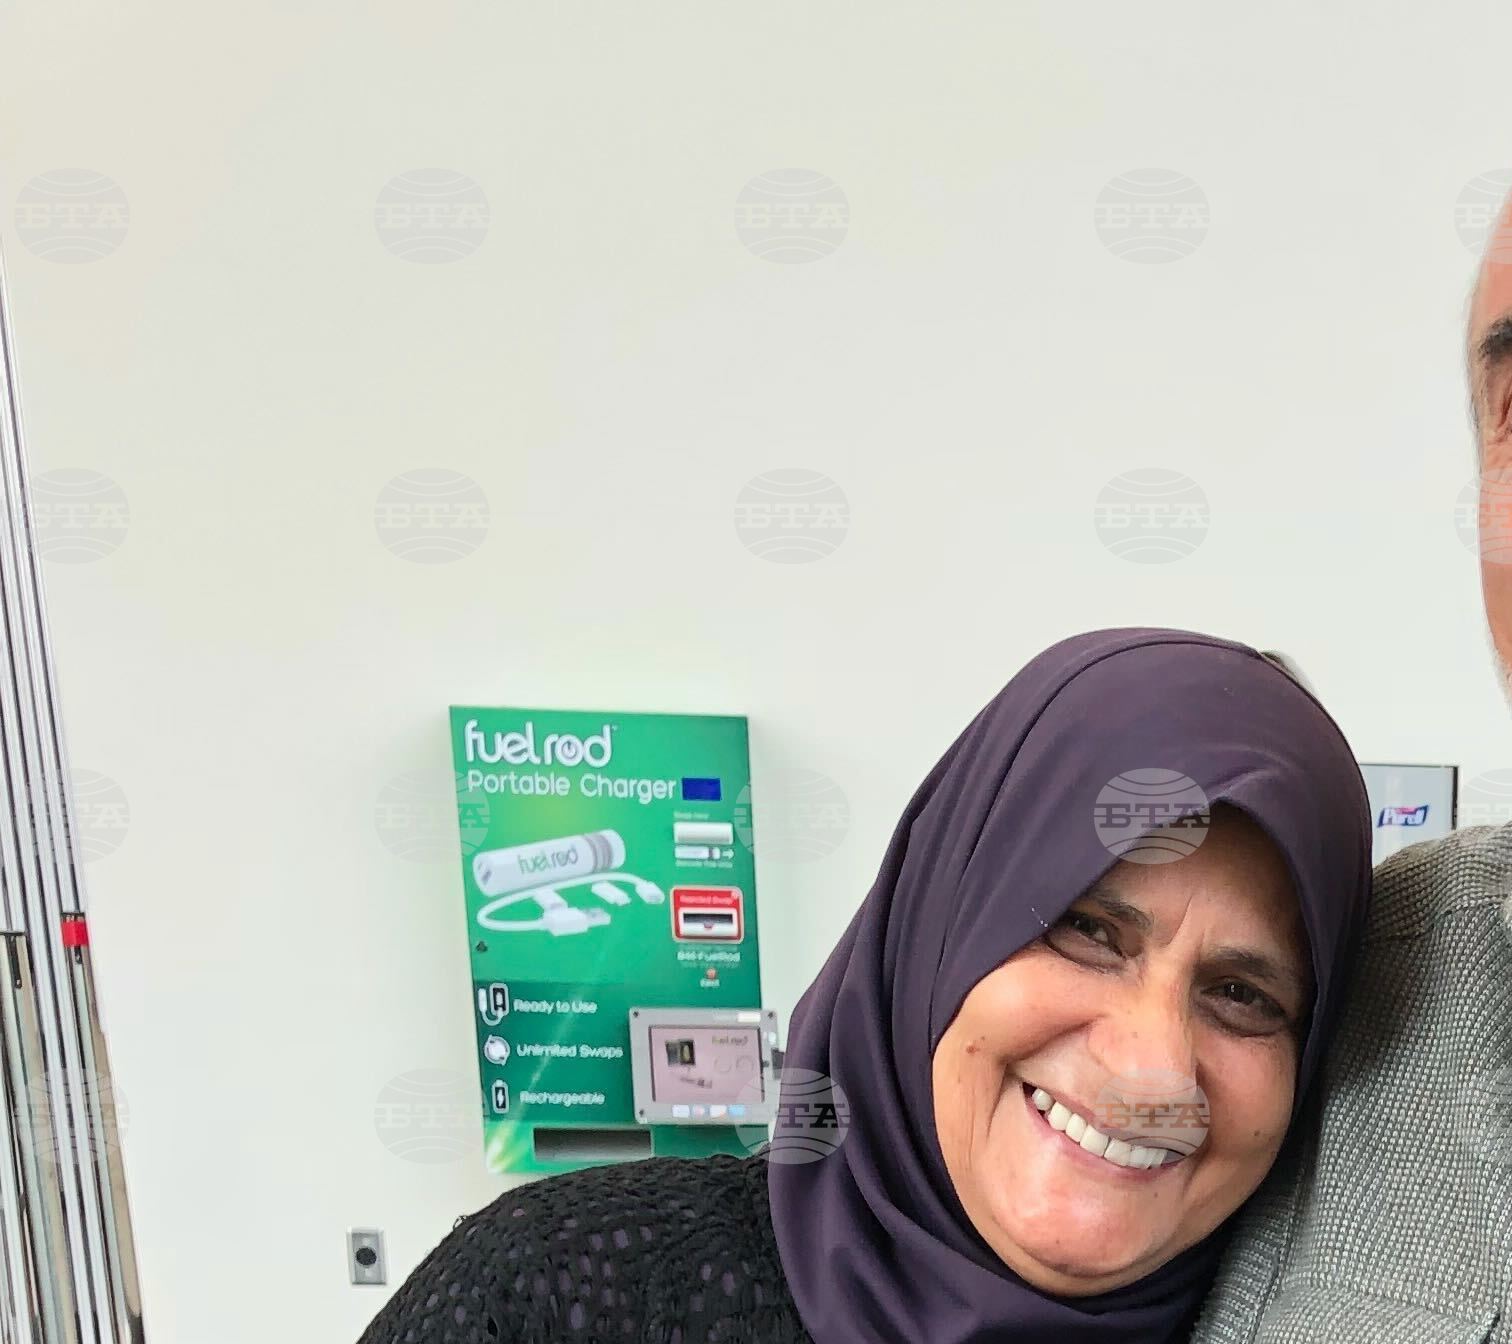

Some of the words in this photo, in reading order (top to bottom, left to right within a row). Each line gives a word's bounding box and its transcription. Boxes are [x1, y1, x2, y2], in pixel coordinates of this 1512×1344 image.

[467, 769, 570, 795] Portable
[580, 773, 676, 804] Charger
[513, 999, 554, 1014] Ready
[556, 1000, 570, 1013] to
[571, 1000, 598, 1014] Use
[516, 1044, 577, 1057] Unlimited
[579, 1044, 624, 1059] Swaps
[519, 1090, 605, 1107] Rechargeable
